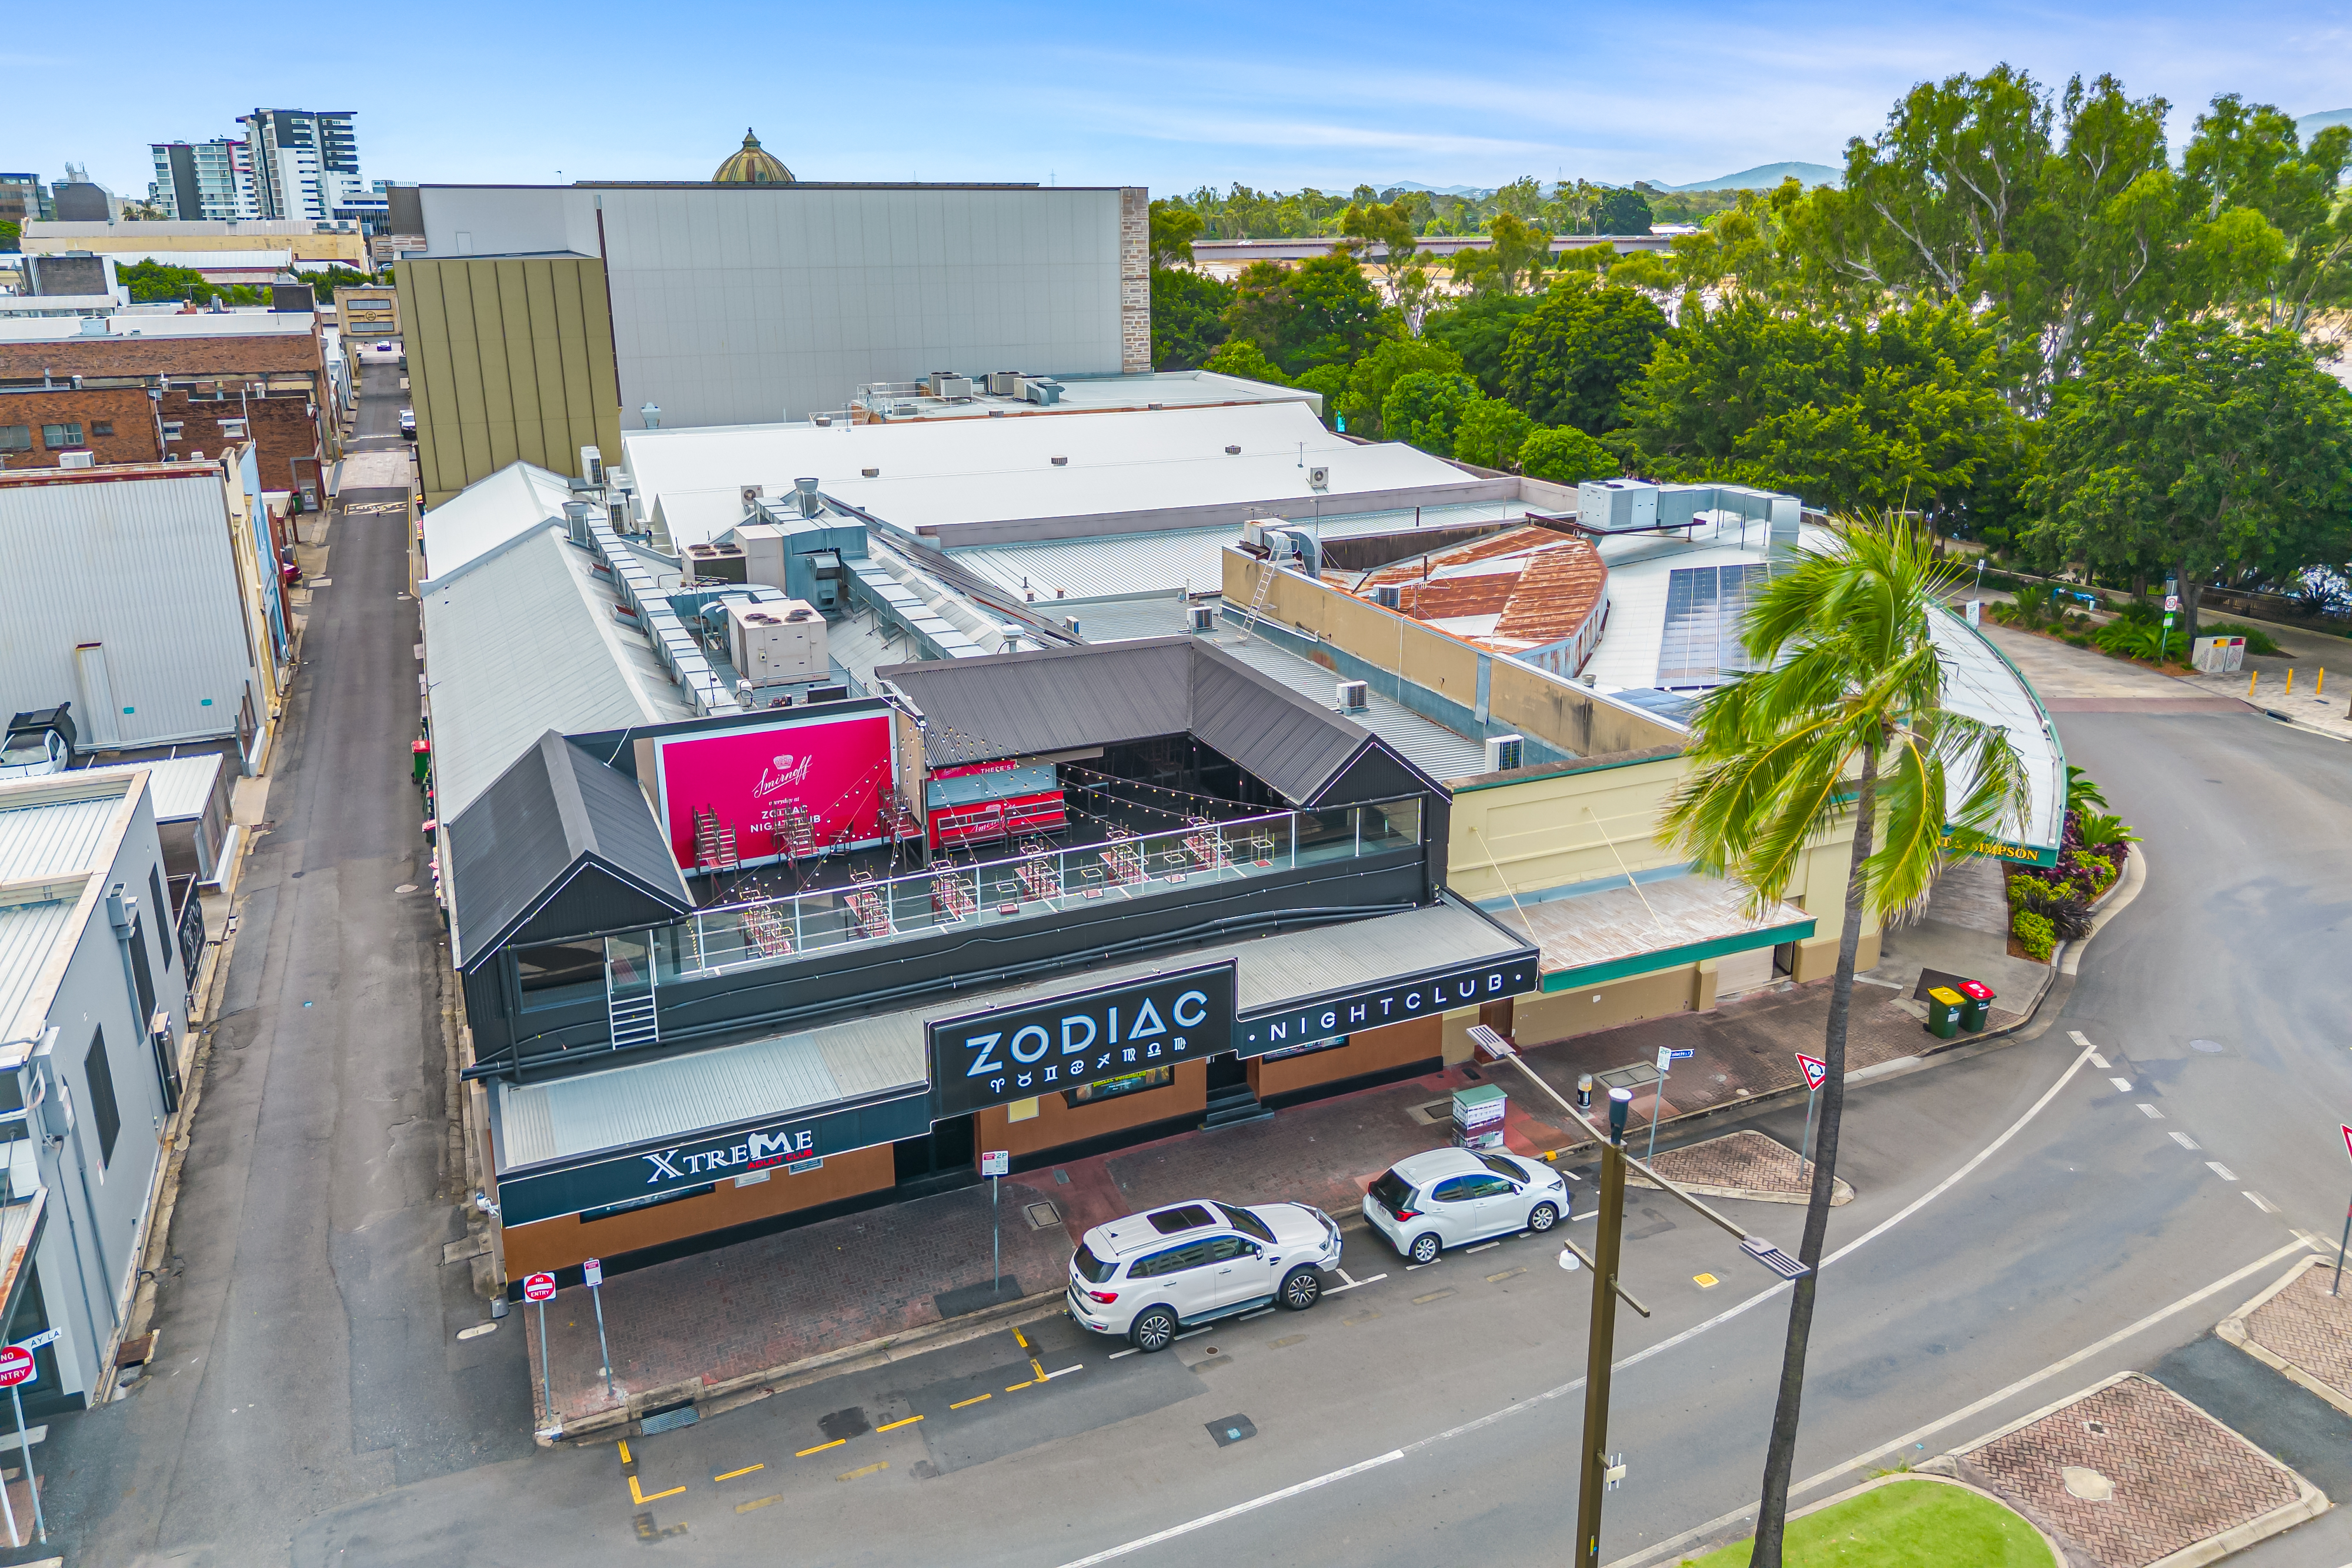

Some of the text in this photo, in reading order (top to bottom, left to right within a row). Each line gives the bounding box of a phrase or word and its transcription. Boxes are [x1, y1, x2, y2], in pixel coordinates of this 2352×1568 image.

[751, 754, 813, 798] Smirnoff
[1270, 974, 1502, 1042] NIGHTCLUB
[965, 989, 1209, 1077] ZODIAC
[747, 1155, 783, 1170] ADULT
[786, 1149, 813, 1161] CLUB
[1, 1352, 14, 1361] NO
[0, 1369, 25, 1381] NTRY
